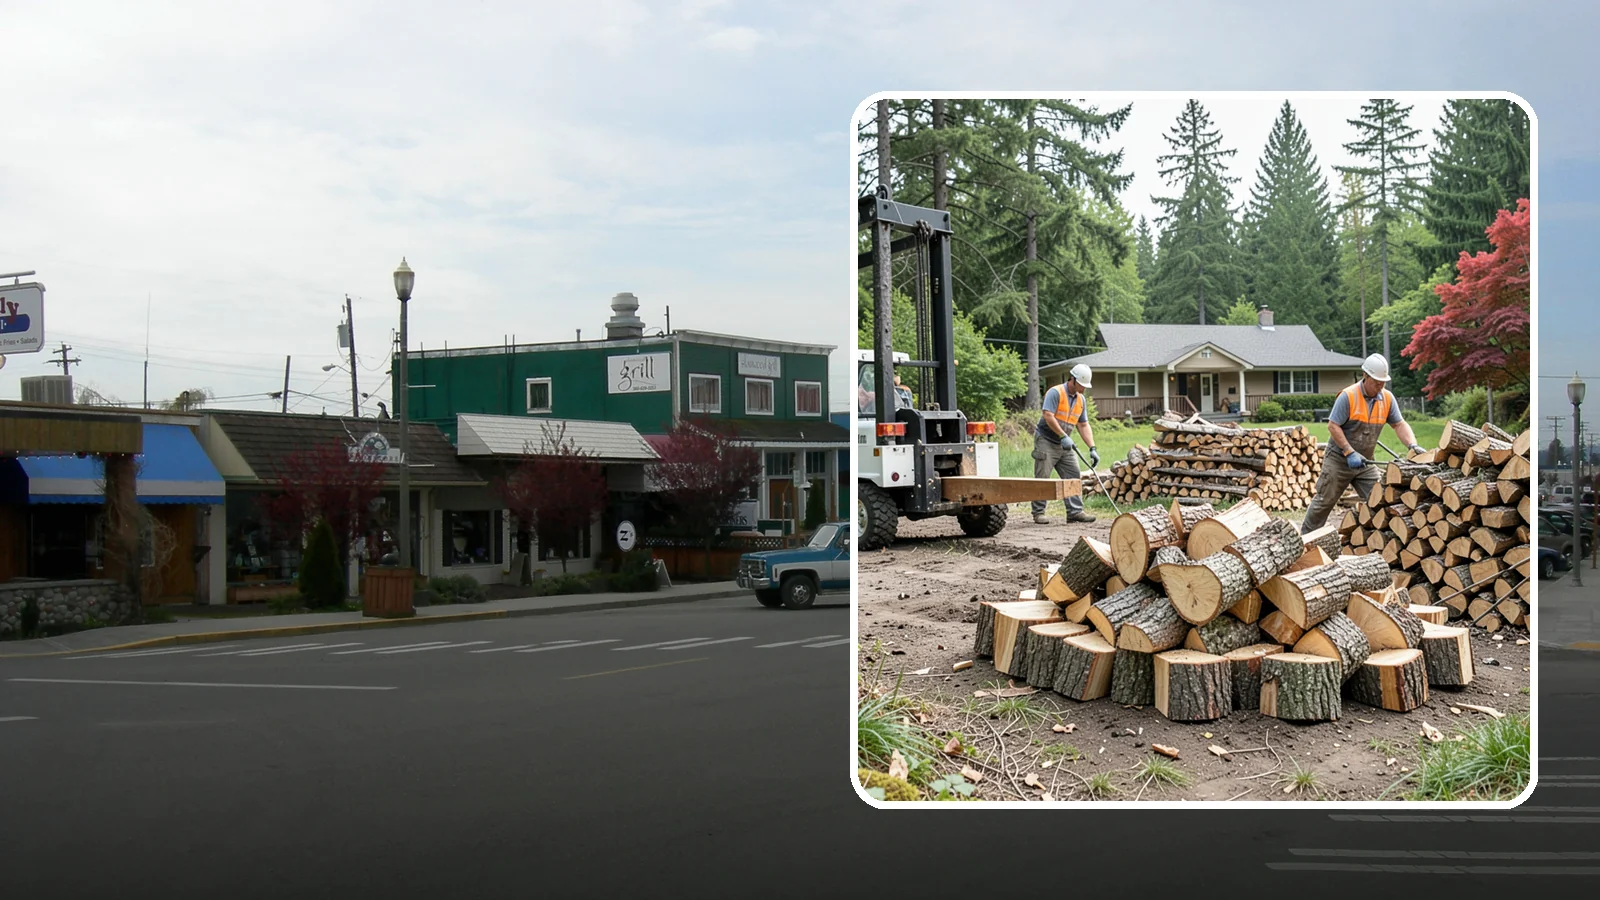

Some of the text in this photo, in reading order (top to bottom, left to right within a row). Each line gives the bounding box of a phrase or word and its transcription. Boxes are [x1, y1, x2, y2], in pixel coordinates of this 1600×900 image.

[3, 338, 16, 346] Fries
[20, 337, 38, 345] Salads
[618, 356, 654, 391] grill
